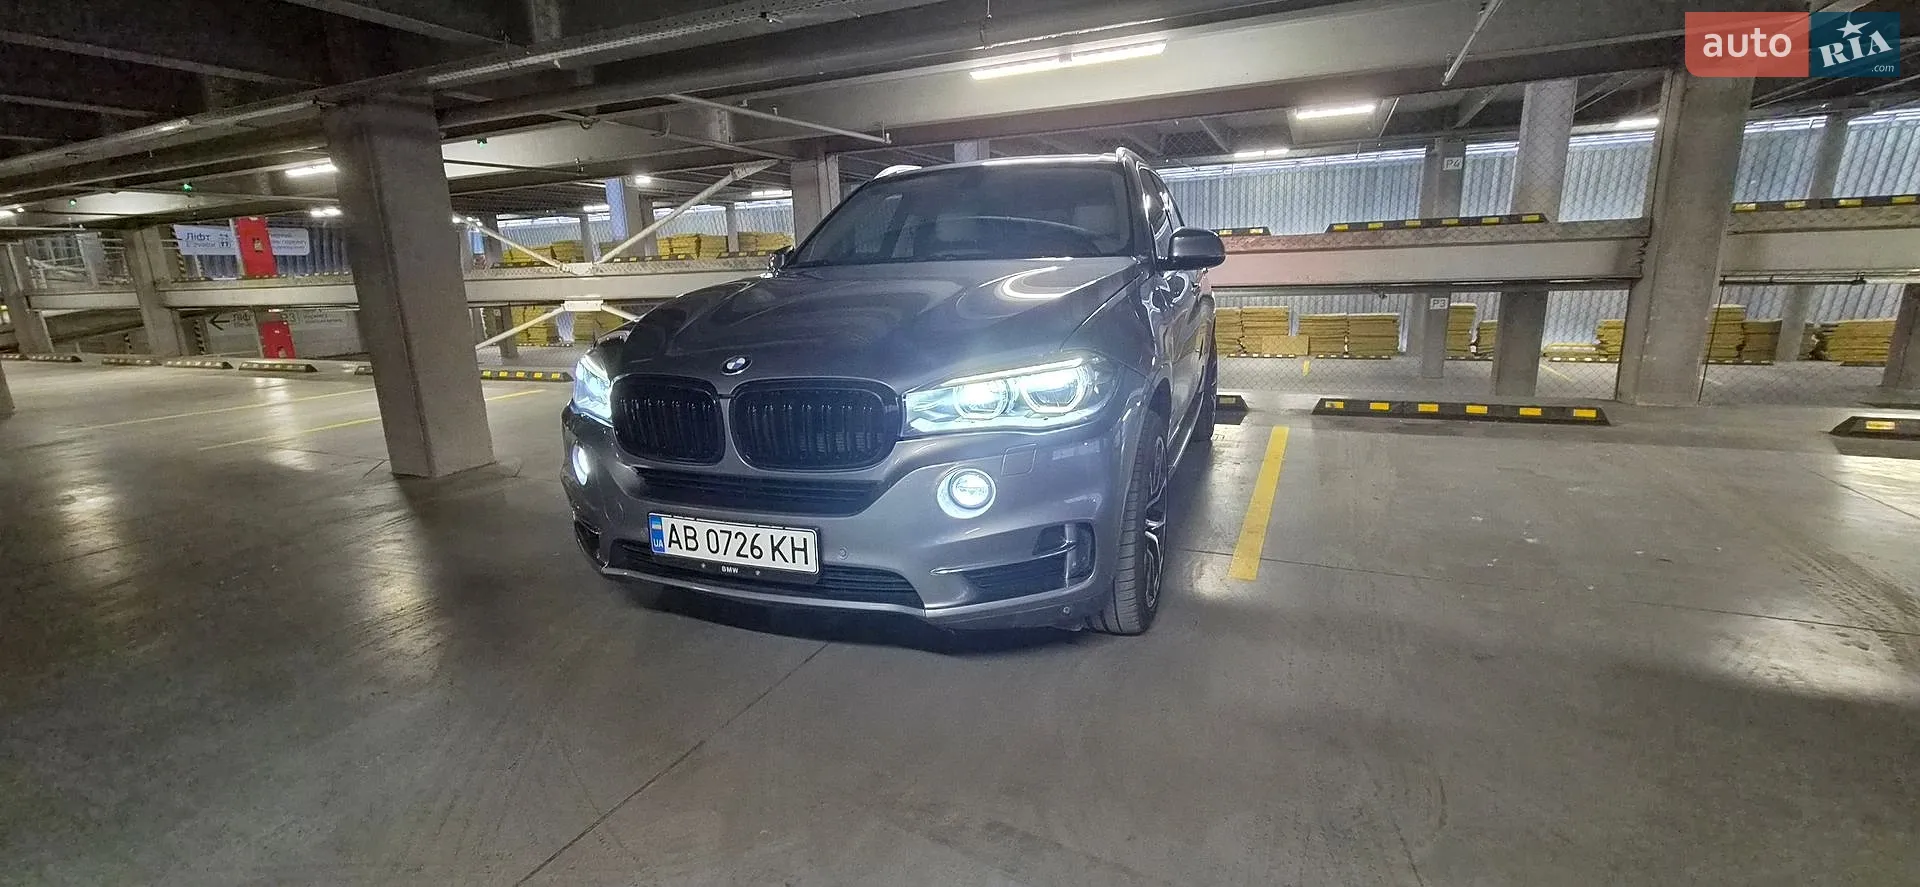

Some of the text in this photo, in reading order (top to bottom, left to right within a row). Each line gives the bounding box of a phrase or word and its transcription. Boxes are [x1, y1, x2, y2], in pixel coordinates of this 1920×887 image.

[1446, 159, 1461, 169] P4
[1432, 299, 1446, 308] P3
[653, 538, 664, 548] UA
[668, 523, 809, 565] AB 0726 KH
[721, 565, 739, 574] BMW
